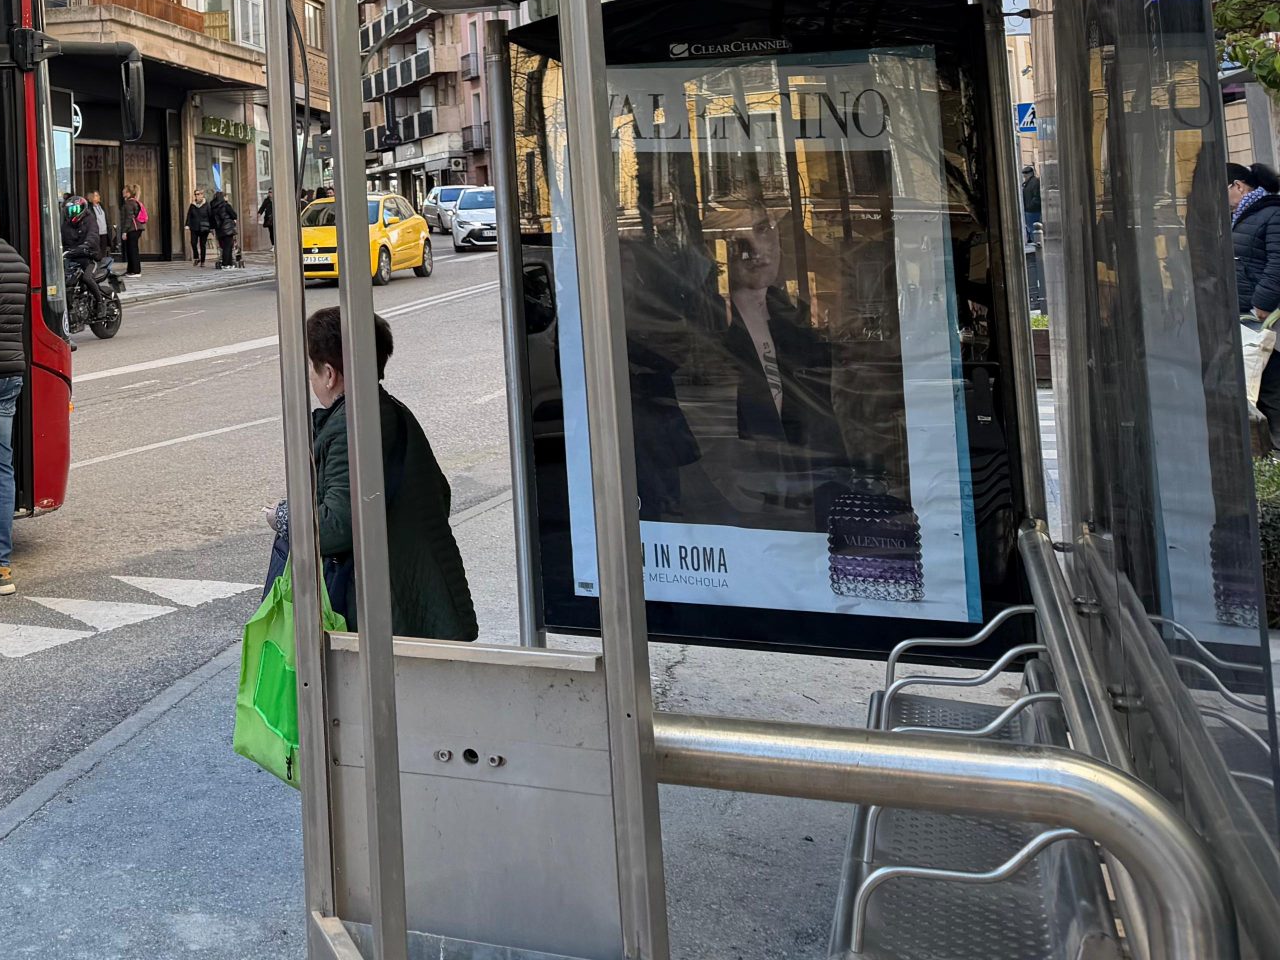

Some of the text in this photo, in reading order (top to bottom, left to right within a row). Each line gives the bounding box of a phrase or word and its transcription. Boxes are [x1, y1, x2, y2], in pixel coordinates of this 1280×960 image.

[843, 534, 907, 550] VALENTINO
[654, 543, 671, 569] IN
[678, 544, 729, 574] ROMA
[648, 572, 729, 589] MELANCHOLIA
